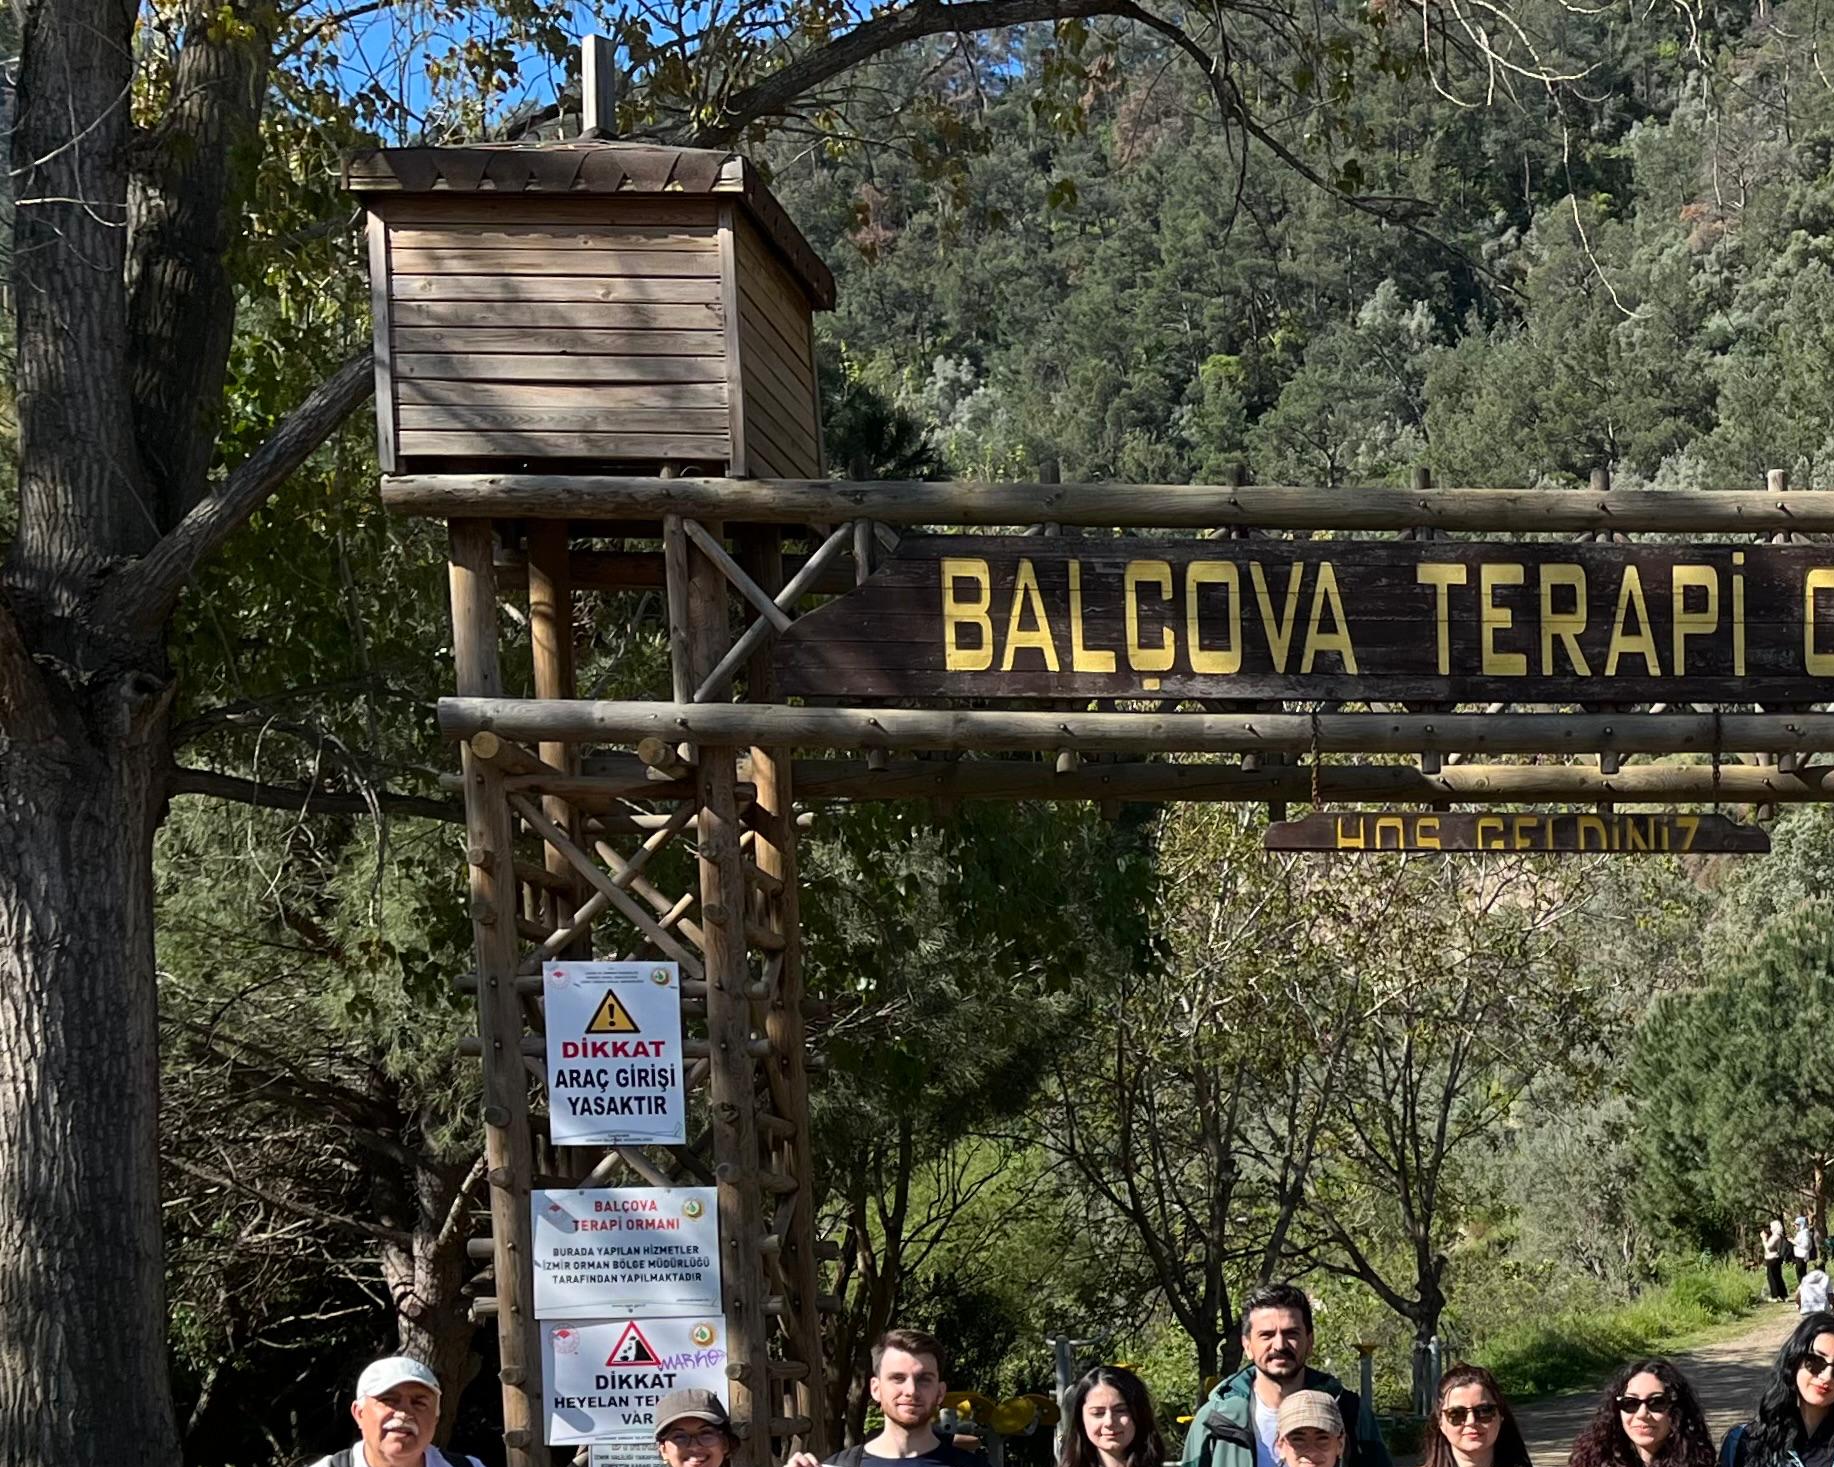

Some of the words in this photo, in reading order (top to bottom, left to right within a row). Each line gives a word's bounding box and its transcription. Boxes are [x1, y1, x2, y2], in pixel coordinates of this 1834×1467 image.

[940, 557, 1359, 691] BALÇOVA
[1416, 551, 1746, 677] TERAPİ
[562, 1037, 666, 1059] DİKKAT
[555, 1069, 609, 1093] ARAÇ
[615, 1063, 676, 1093] GİRİŞİ
[567, 1096, 668, 1116] YASAKTIR
[594, 1200, 659, 1214] BALÇOVA
[572, 1216, 622, 1232] TERAPİ
[626, 1219, 680, 1231] ORMANI
[553, 1247, 595, 1257] BURADA
[597, 1246, 641, 1256] YAPILAN
[643, 1244, 699, 1256] HİZMETLER
[573, 1260, 610, 1270] ORMAN
[612, 1258, 645, 1269] BÖLGE
[552, 1274, 618, 1284] TARAFINDAN
[620, 1272, 702, 1283] YAPILMAKTADIR
[595, 1371, 677, 1390] DİKKAT
[554, 1395, 629, 1409] HEYELAN
[621, 1413, 654, 1425] VAR
